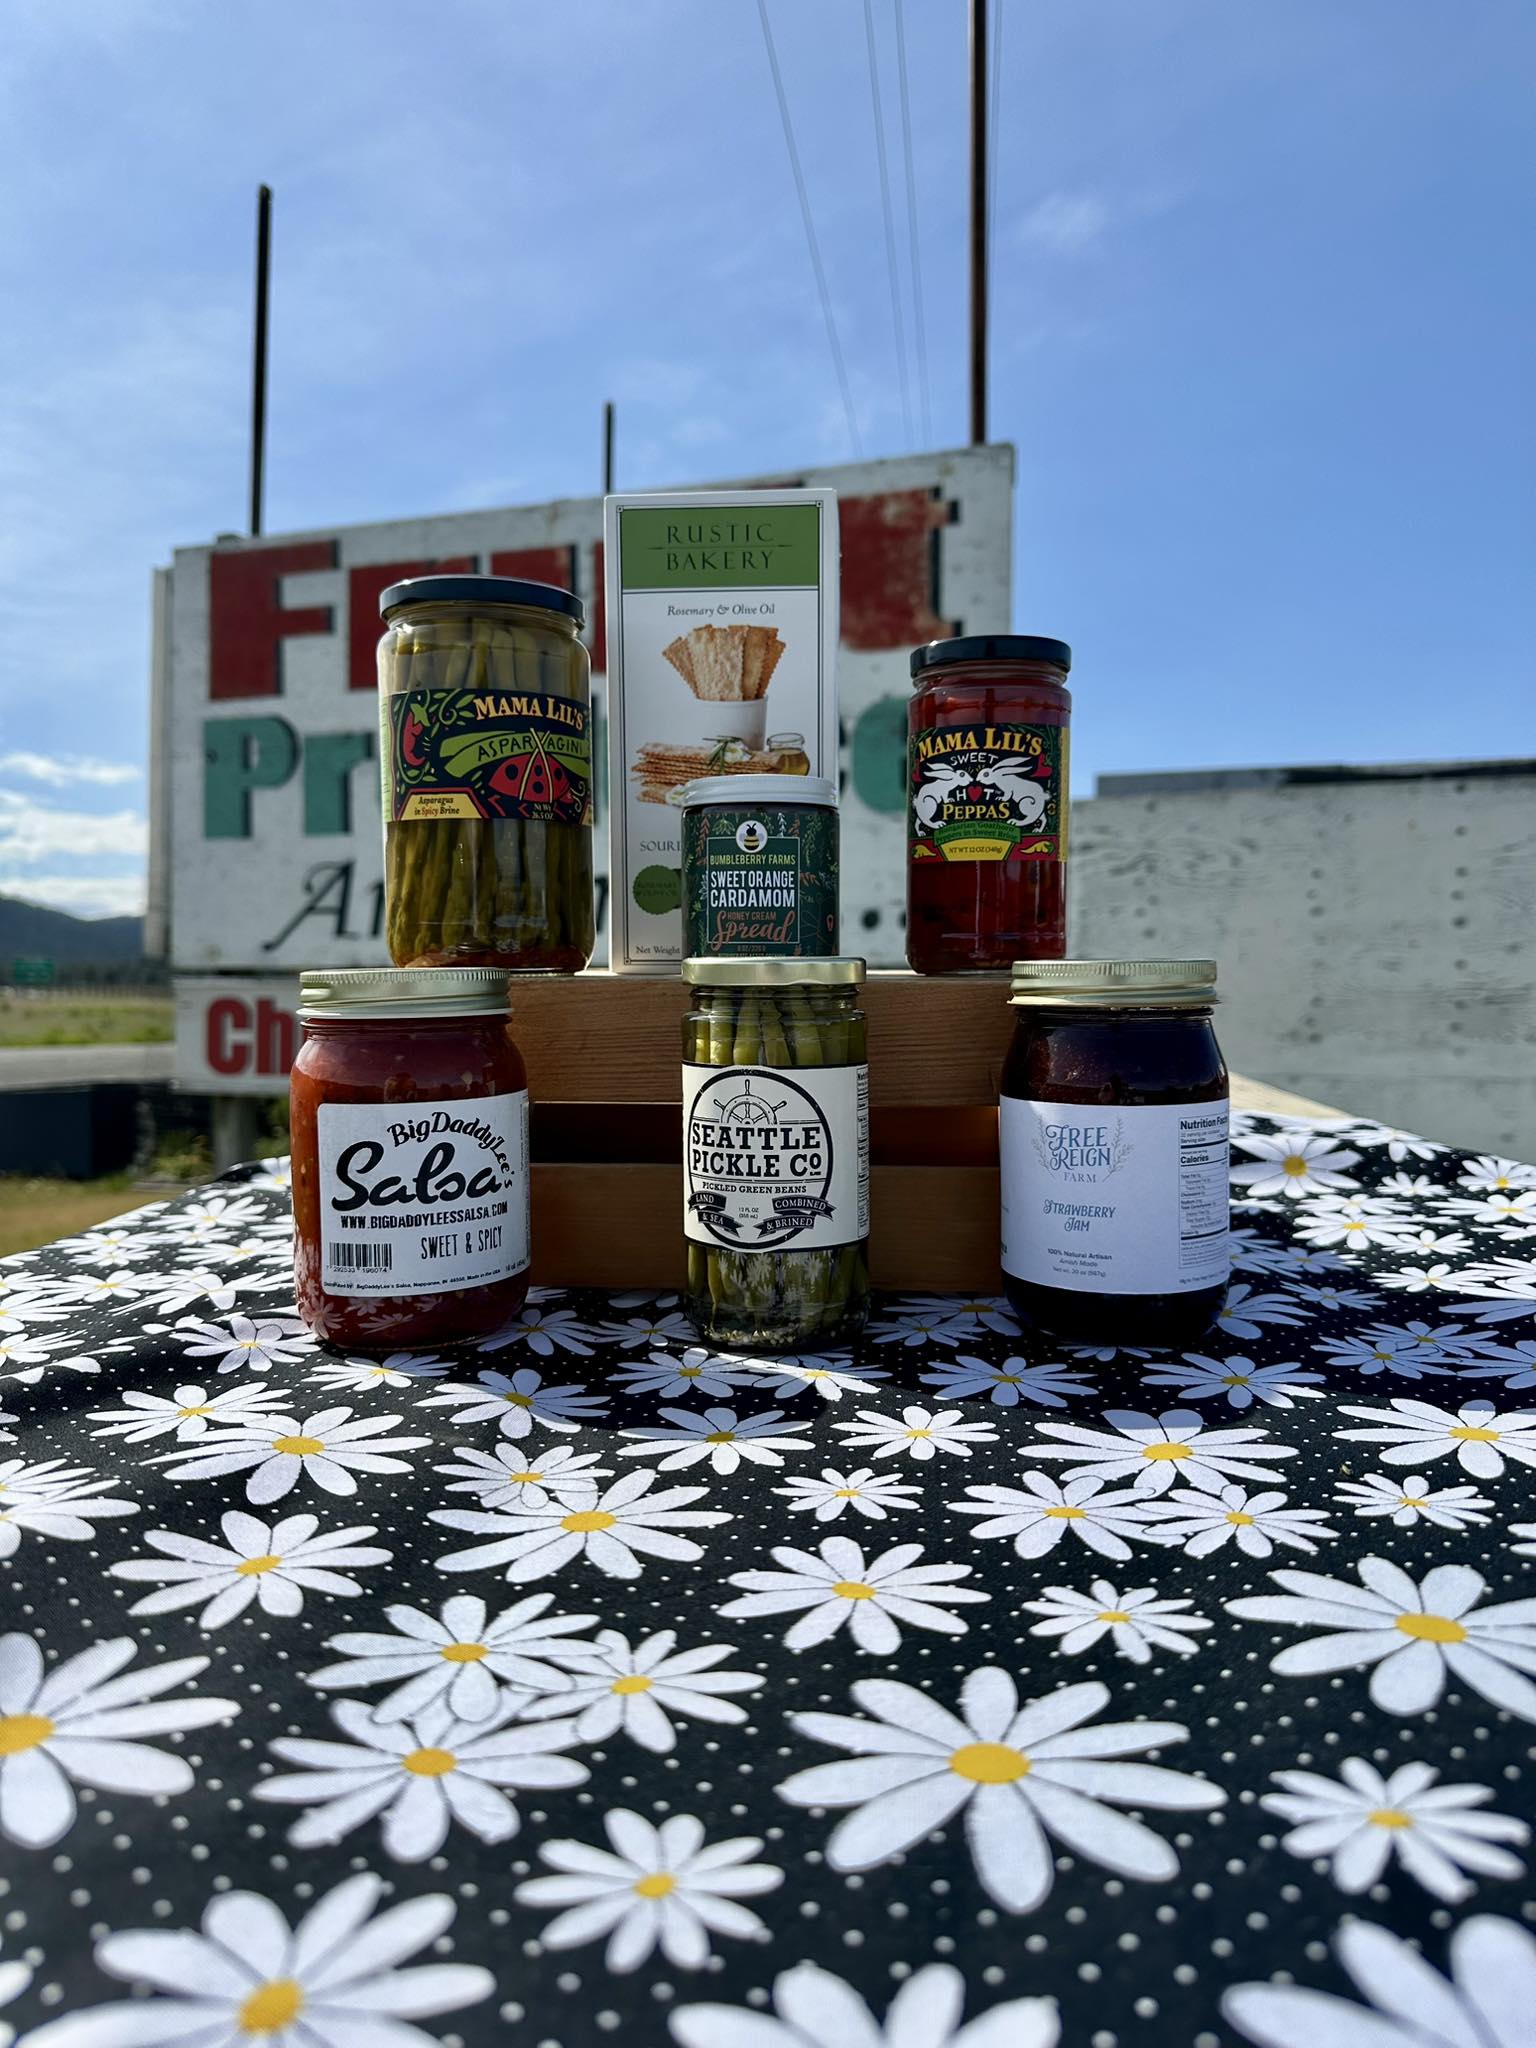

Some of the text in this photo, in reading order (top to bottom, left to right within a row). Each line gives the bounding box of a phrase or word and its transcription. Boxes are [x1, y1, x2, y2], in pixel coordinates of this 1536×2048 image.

[667, 523, 774, 544] RUSTIC
[667, 550, 773, 571] BAKERY
[667, 603, 775, 617] Rosemary & Olive Oil
[473, 695, 584, 731] MAMA LIL'S
[918, 727, 1044, 762] MAMA LIL'S
[950, 752, 999, 766] SWEET
[418, 796, 454, 805] Asparagus
[421, 807, 438, 816] Spicy
[440, 806, 460, 815] Brine
[942, 801, 1010, 821] PEPPAS
[710, 855, 796, 865] BUMBLEBERRY FARMS
[710, 870, 795, 888] SWEET ORANGE
[710, 889, 795, 908] CARDAMOM
[727, 911, 777, 921] HONEY CREAM
[711, 910, 796, 952] Spread
[636, 946, 680, 956] Net Weight
[1180, 1118, 1217, 1130] Nutrition
[692, 1122, 821, 1150] SEATTLE
[1045, 1124, 1108, 1151] FREE
[692, 1148, 780, 1177] PICKLE
[1050, 1147, 1111, 1170] REIGN
[1180, 1154, 1209, 1164] Calories
[331, 1141, 502, 1211] Salsa
[1063, 1172, 1096, 1183] FARM
[702, 1181, 807, 1194] PICKLED GREEN BEANS
[695, 1193, 715, 1204] LAND
[774, 1198, 827, 1211] COMBINED
[341, 1201, 508, 1229] WWW.BIGDADDYLEESSALSA.COM
[1043, 1199, 1116, 1218] STRAWBERRY
[702, 1213, 724, 1225] & SEA
[766, 1217, 813, 1230] & BRINED
[1064, 1217, 1090, 1232] JAM
[421, 1225, 503, 1260] SWEET & SPICY
[1063, 1250, 1087, 1258] Natural
